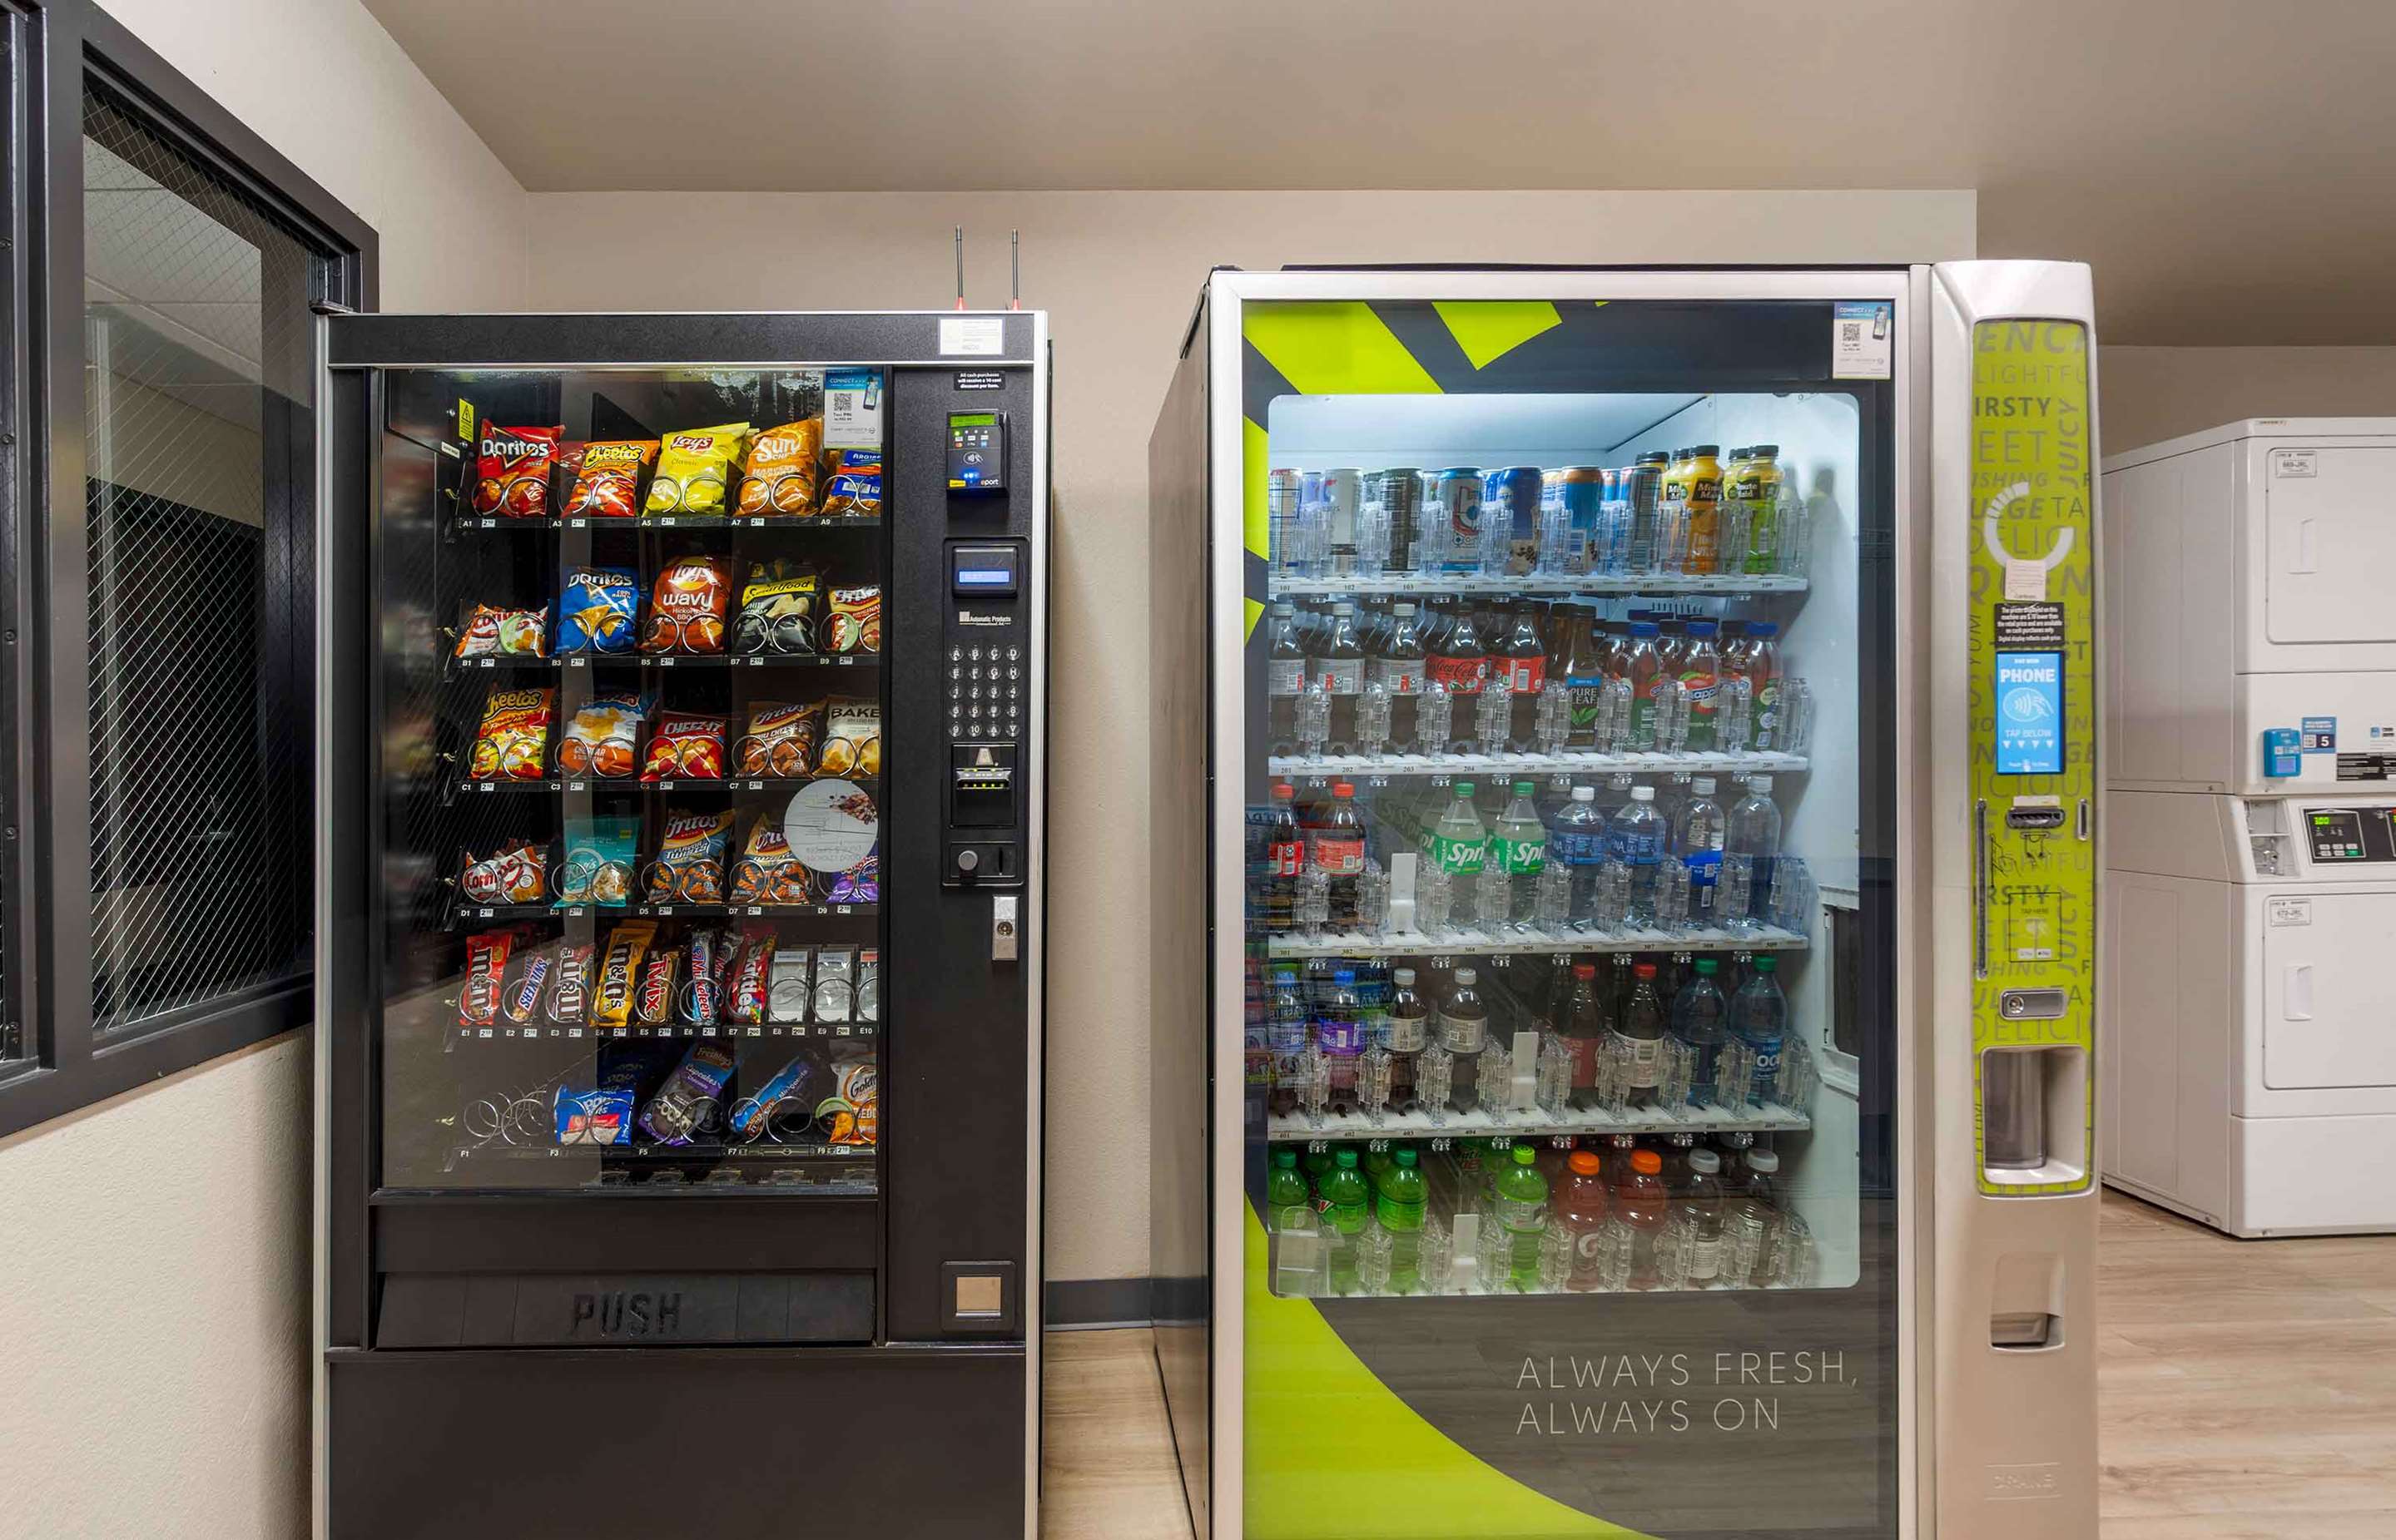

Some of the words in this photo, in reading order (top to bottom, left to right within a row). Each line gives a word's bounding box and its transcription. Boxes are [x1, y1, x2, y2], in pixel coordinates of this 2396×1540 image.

[482, 439, 549, 458] Doritos
[568, 573, 632, 588] Doritos
[749, 581, 810, 597] Sartfood
[662, 592, 714, 611] wavy
[2000, 668, 2056, 683] PHONE
[2320, 735, 2329, 747] 5
[573, 1292, 682, 1335] PUSH
[1516, 1354, 1689, 1389] ALWAYS
[1715, 1351, 1858, 1388] FRESH,
[1516, 1399, 1689, 1434] ALWAYS
[1714, 1398, 1778, 1431] ON
